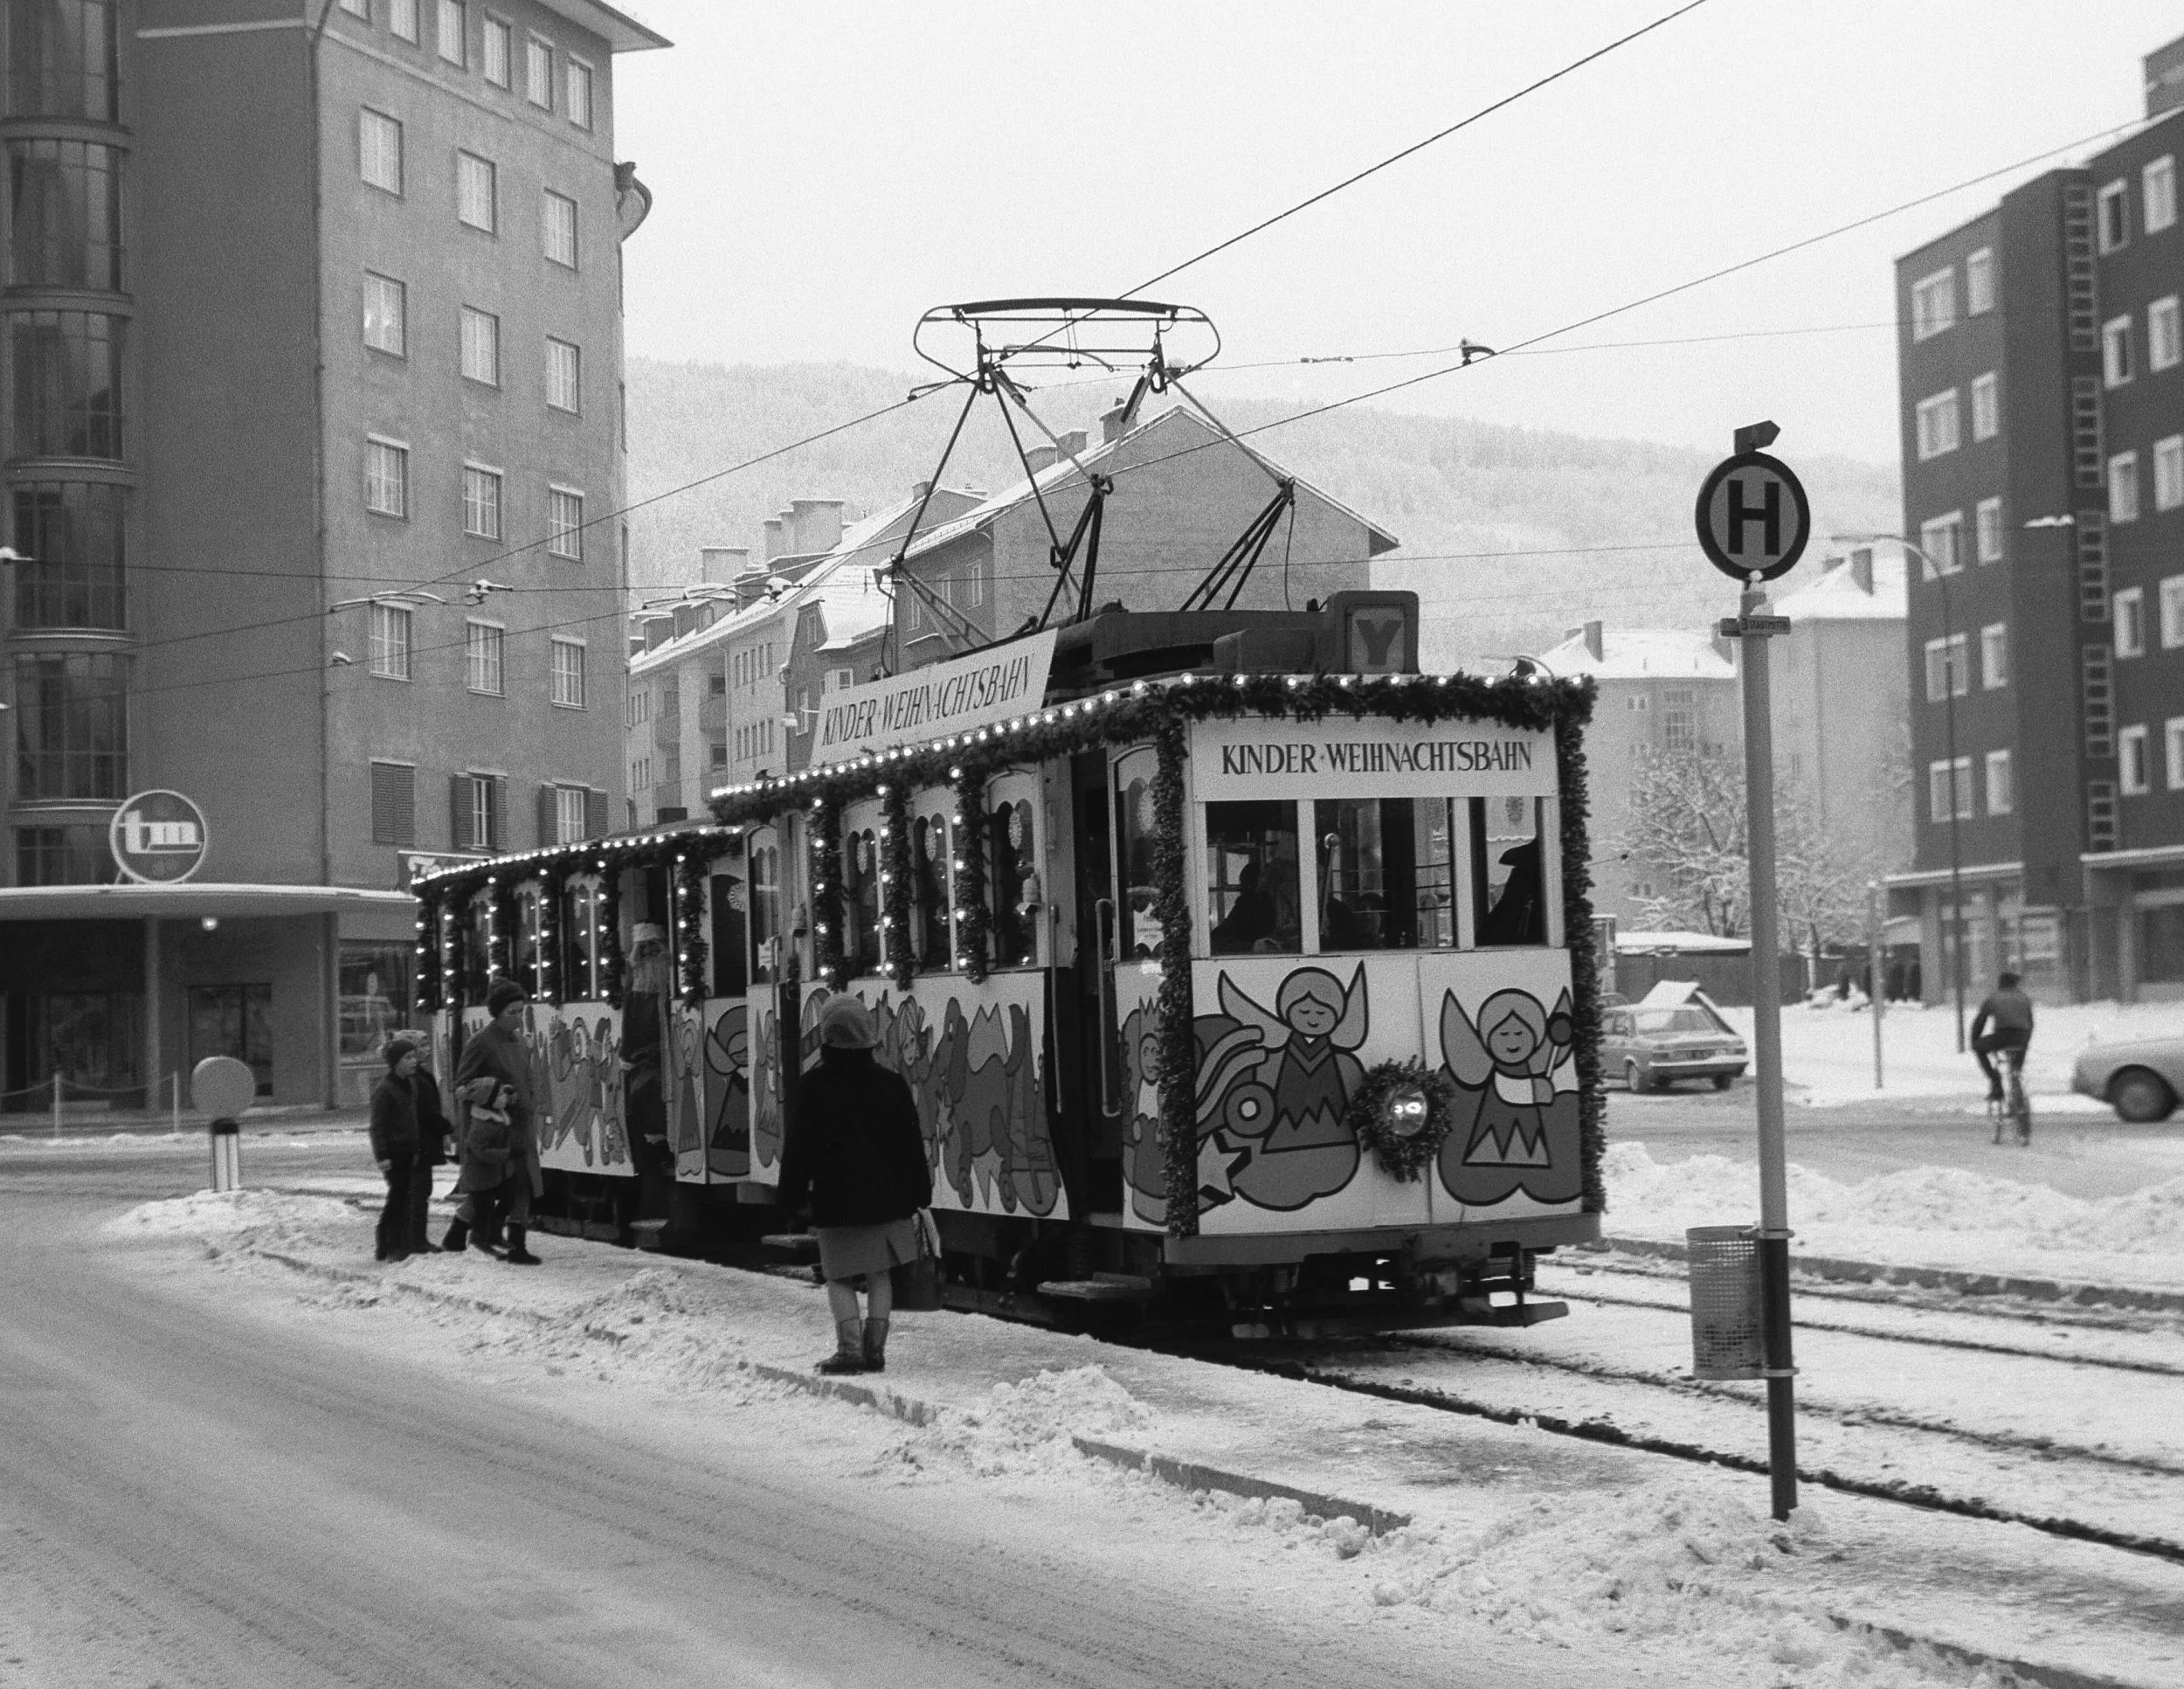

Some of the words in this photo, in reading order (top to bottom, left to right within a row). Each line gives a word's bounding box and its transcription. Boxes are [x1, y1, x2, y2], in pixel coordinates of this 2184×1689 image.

[1727, 479, 1780, 557] H
[1356, 619, 1402, 666] Y
[1221, 744, 1318, 775] KINDER
